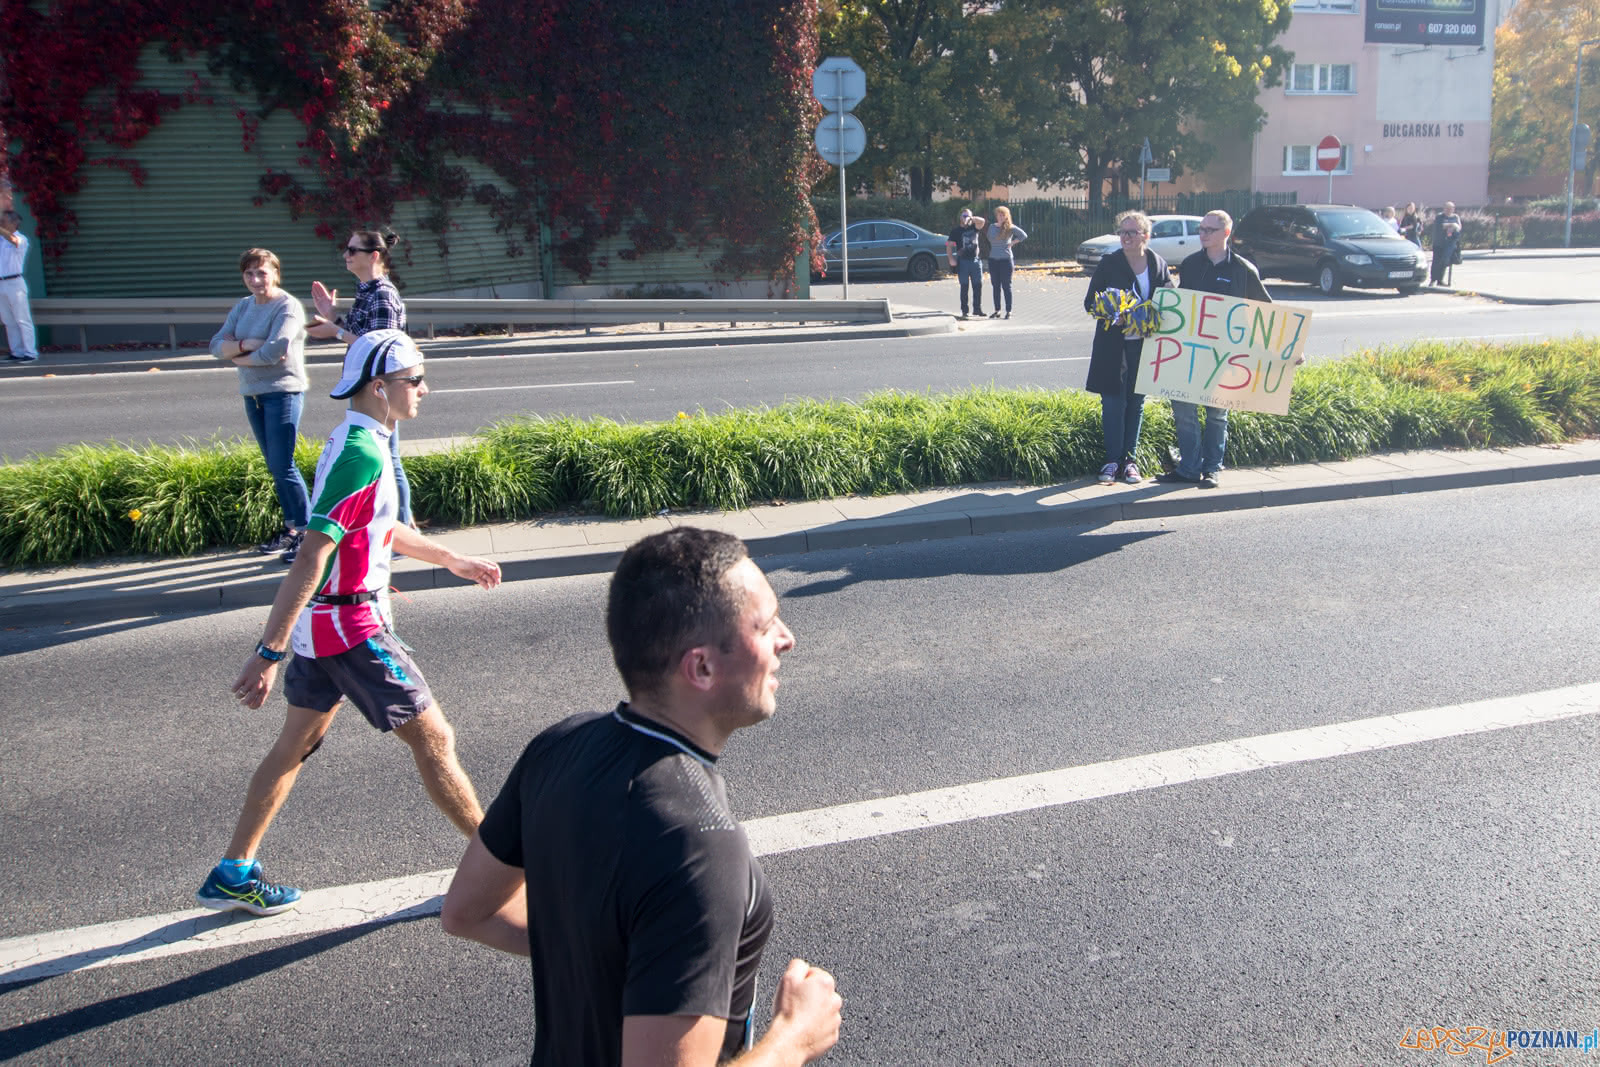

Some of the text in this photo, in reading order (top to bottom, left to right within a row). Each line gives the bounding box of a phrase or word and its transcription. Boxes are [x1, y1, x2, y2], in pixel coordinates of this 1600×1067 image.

[1428, 23, 1476, 34] 607 320 000
[1447, 123, 1465, 137] 126
[1156, 288, 1306, 361] BIEGNIJ
[1149, 336, 1287, 394] PTYSIU
